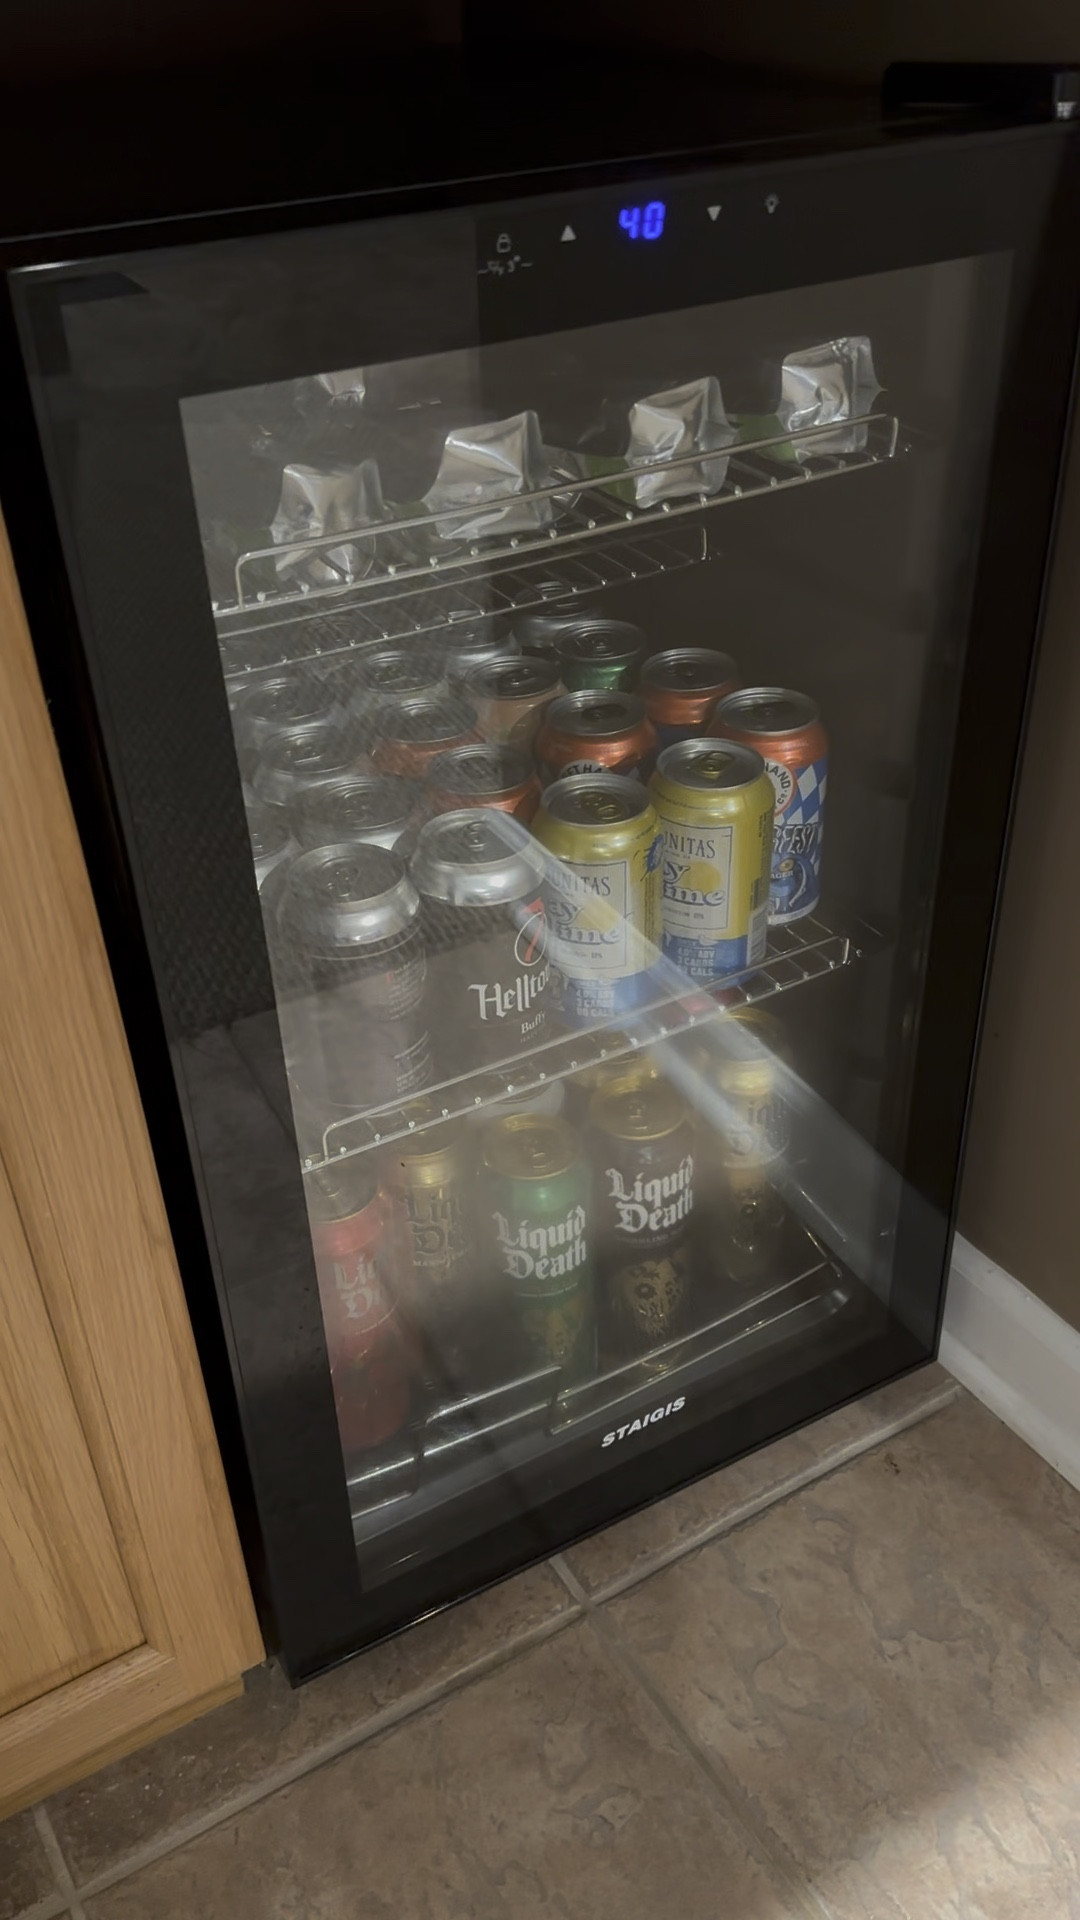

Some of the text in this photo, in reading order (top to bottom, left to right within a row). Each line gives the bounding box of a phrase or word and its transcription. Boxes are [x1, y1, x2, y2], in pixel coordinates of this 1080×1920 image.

[618, 201, 666, 240] 40
[605, 1154, 694, 1209] Liquid
[491, 1204, 586, 1257] Liquid
[615, 1187, 693, 1234] Death
[502, 1236, 587, 1280] Death
[601, 1396, 686, 1448] STAIGIS
